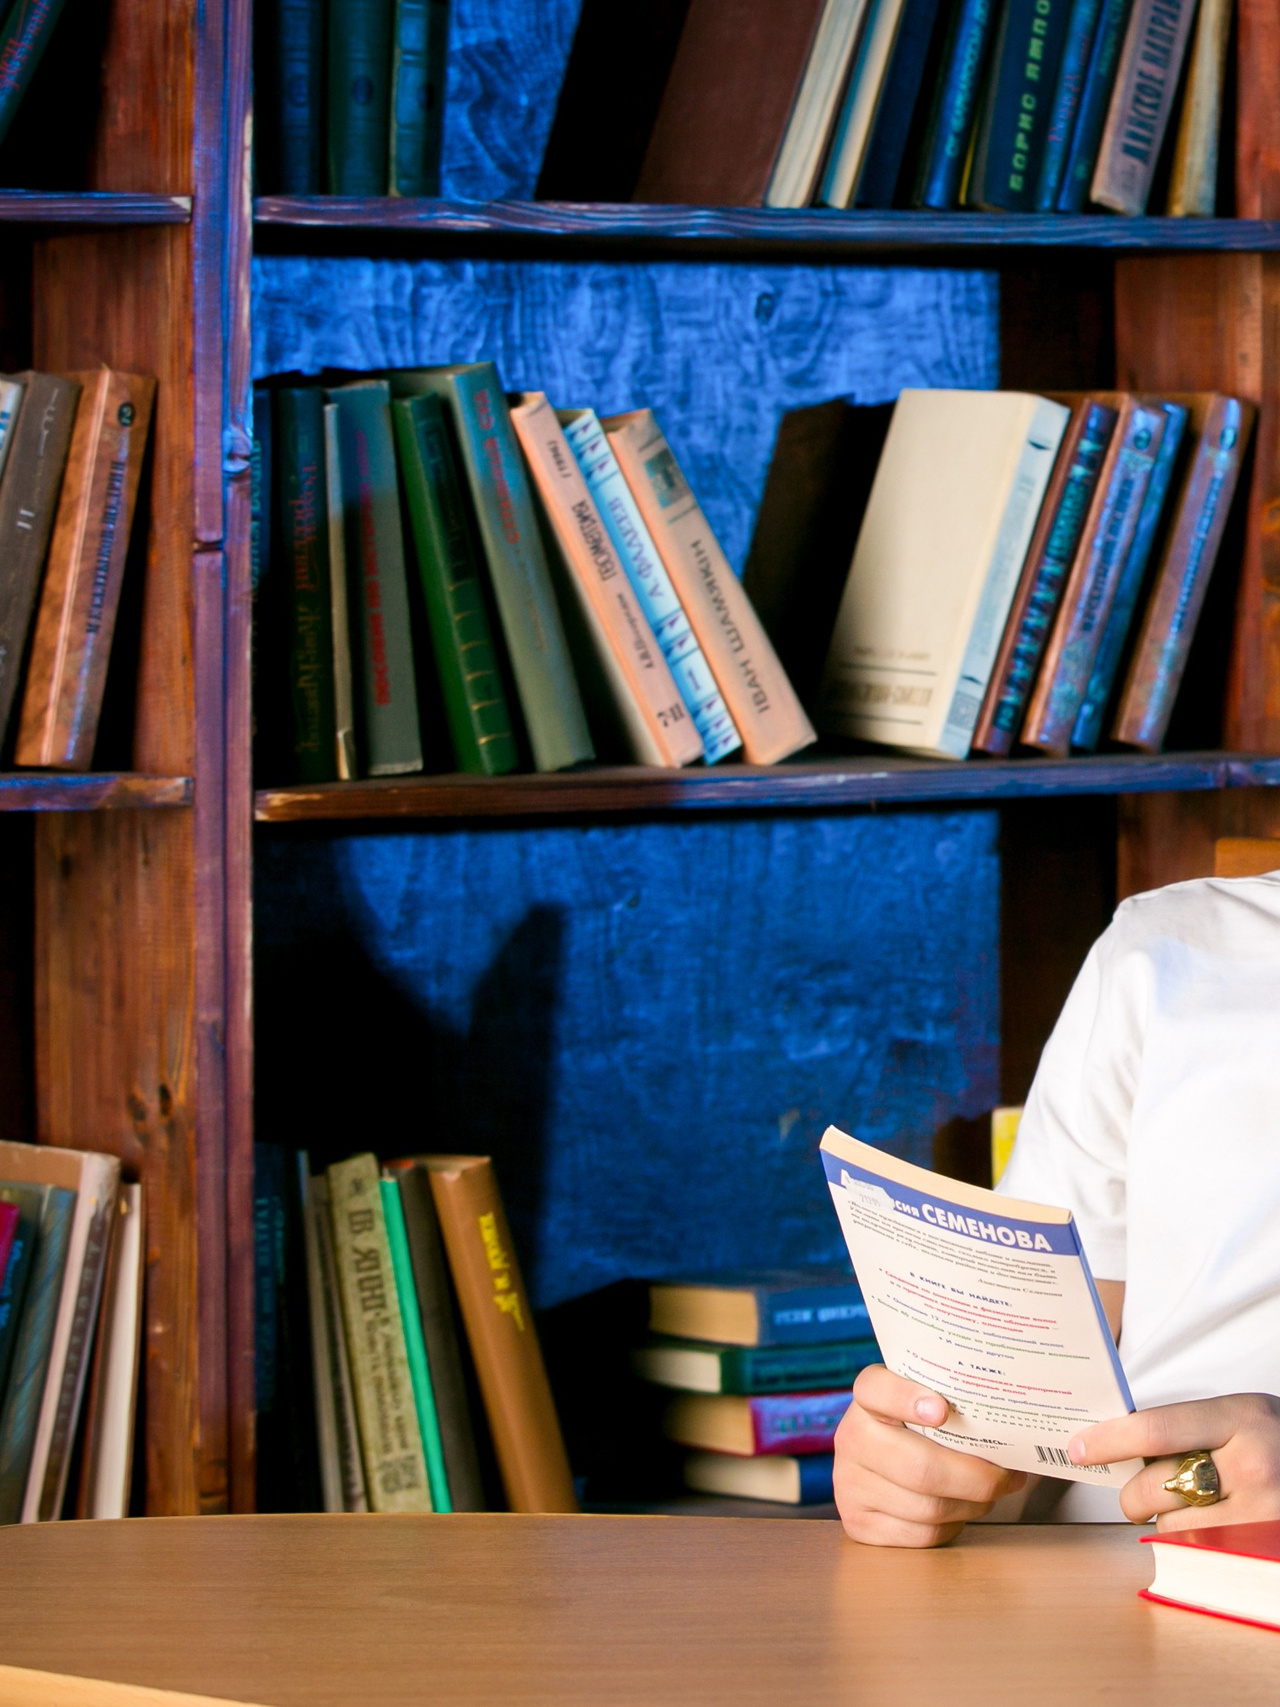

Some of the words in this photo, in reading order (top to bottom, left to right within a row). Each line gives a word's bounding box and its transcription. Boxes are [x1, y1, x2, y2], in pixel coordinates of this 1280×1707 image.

[607, 495, 652, 580] ФАДЕЕВ
[922, 1203, 1053, 1252] СЕМЕНОВА
[919, 1275, 946, 1290] КНИГЕ
[950, 1286, 965, 1296] ВЫ
